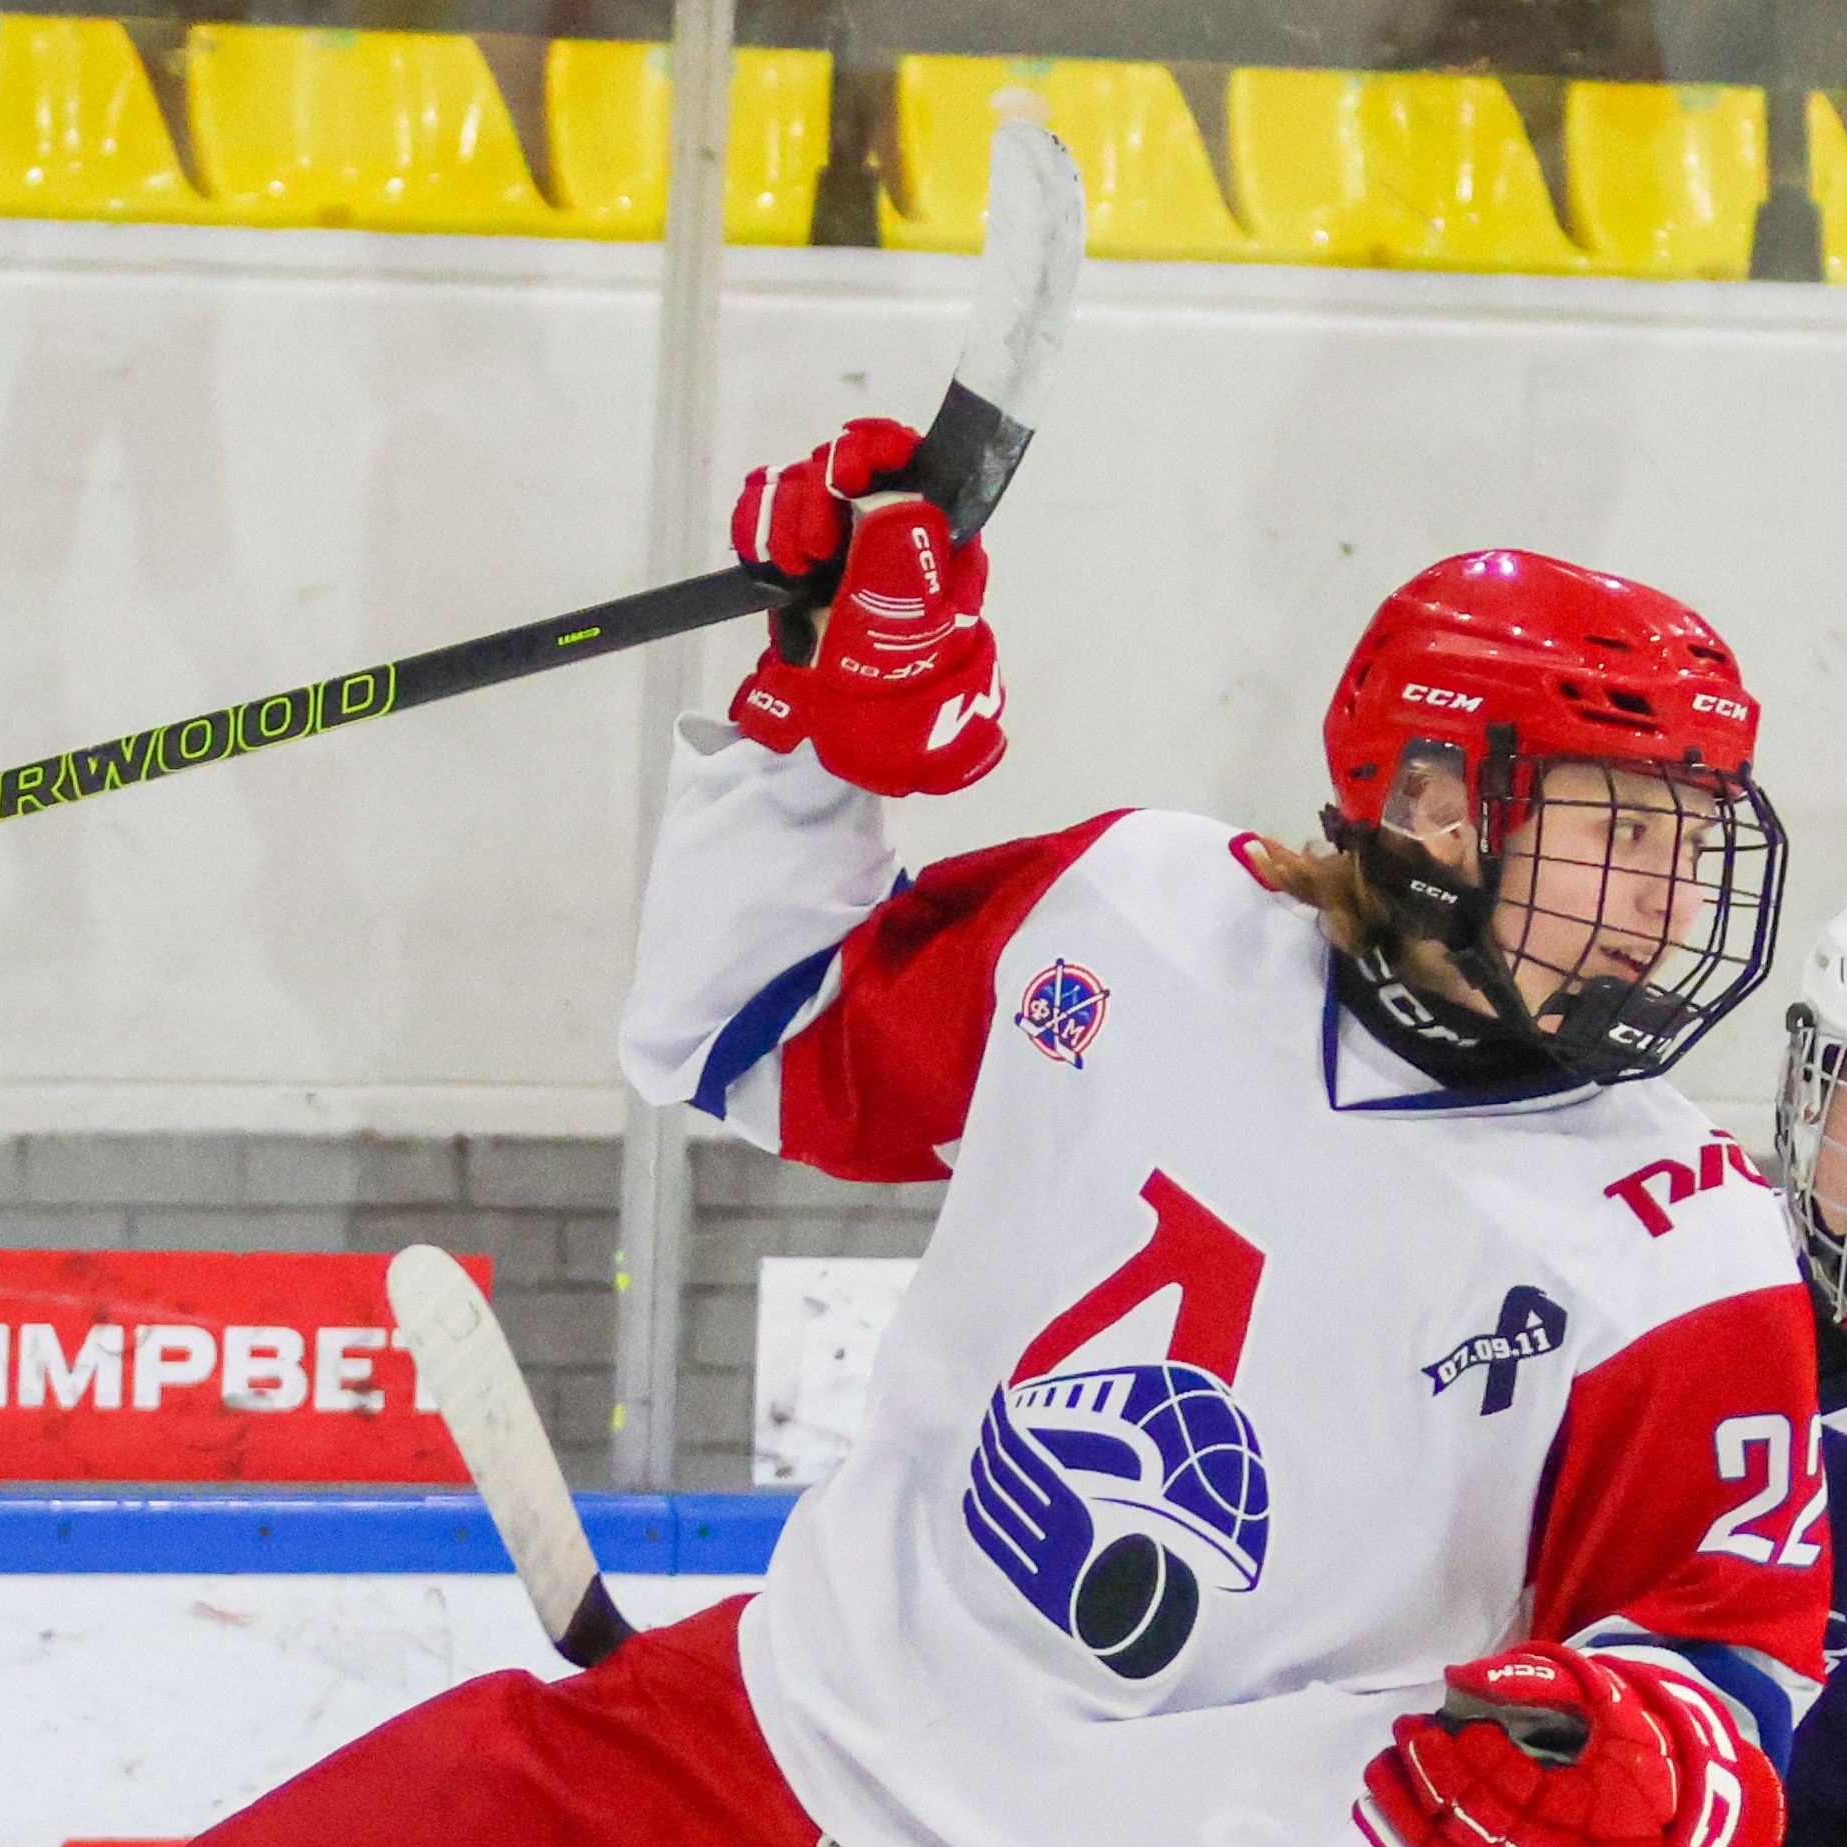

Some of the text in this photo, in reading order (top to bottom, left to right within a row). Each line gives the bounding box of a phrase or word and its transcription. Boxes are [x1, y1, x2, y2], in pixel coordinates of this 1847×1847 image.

[910, 526, 941, 595] CCM
[1401, 682, 1485, 714] CCM
[1692, 692, 1749, 722] CCM
[1409, 879, 1459, 905] CCM
[1437, 1326, 1553, 1384] 07.09.11
[1695, 1412, 1830, 1568] 22
[1487, 1663, 1557, 1682] CCM
